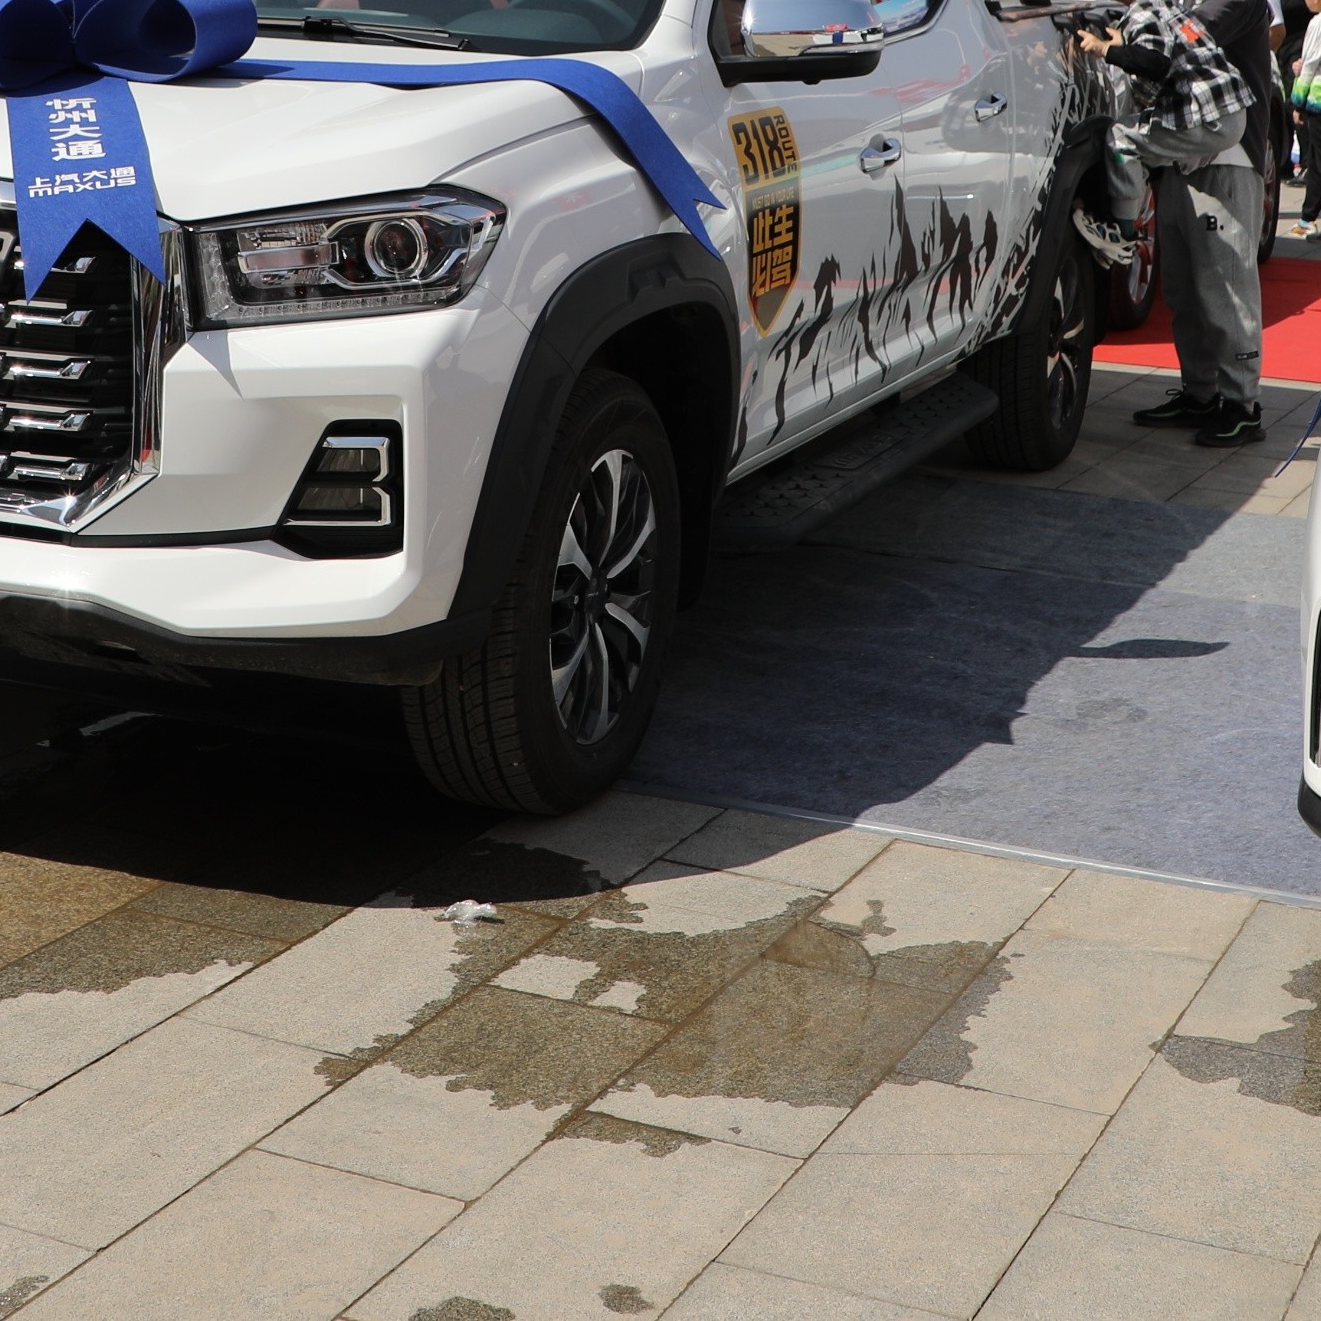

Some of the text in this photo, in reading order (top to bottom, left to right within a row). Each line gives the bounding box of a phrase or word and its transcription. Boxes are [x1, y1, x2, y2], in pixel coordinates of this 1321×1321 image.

[45, 98, 106, 161] 忻州大通
[732, 117, 787, 186] 318
[774, 114, 797, 174] ROUTE
[28, 166, 136, 188] 上汽大通
[29, 177, 136, 198] MAXUS
